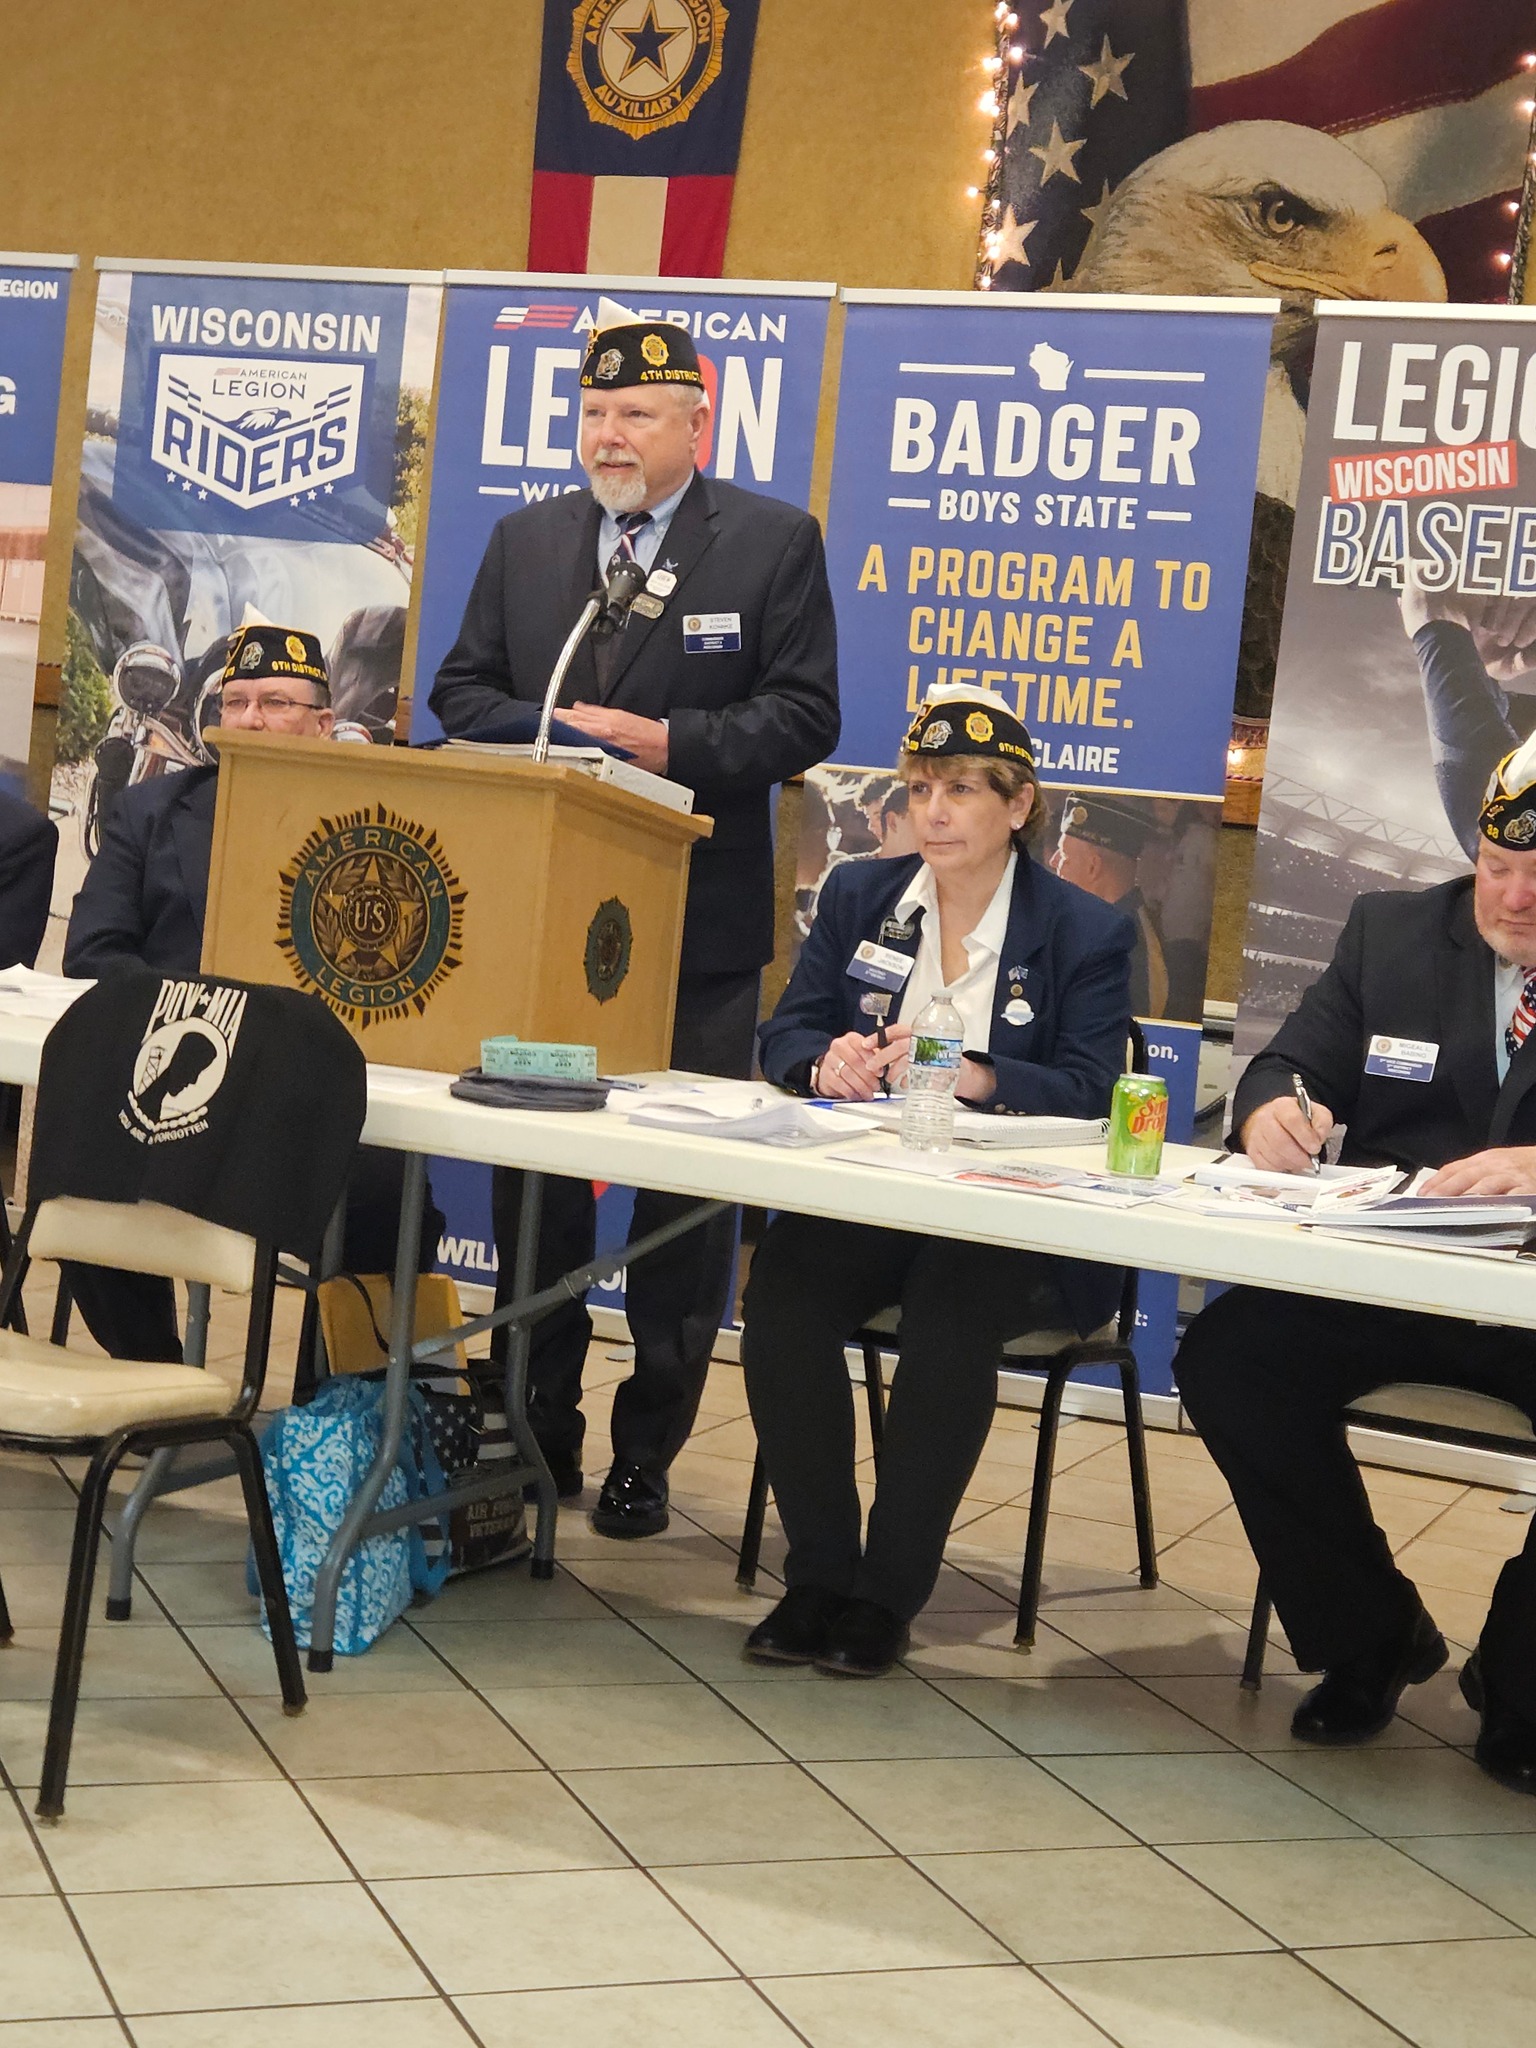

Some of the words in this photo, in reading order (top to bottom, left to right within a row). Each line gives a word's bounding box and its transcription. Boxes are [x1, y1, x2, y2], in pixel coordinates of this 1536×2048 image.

[593, 84, 684, 119] AUXILIARY
[151, 304, 382, 354] WISCONSIN
[211, 379, 306, 401] LEGION
[239, 368, 308, 381] AMERICAN
[640, 369, 664, 382] 4TH
[162, 405, 348, 496] RIDERS
[889, 397, 1201, 486] BADGER
[1334, 446, 1511, 500] WISCONSIN
[938, 489, 1020, 524] BOYS
[1034, 494, 1139, 530] STATE
[857, 544, 888, 593] A
[907, 546, 1135, 607] PROGRAM
[1154, 560, 1212, 612] TO
[907, 606, 1093, 665] CHANGE
[1111, 619, 1143, 669] A
[1030, 737, 1121, 775] CLAIRE
[304, 828, 444, 900] AMERICAN
[315, 965, 417, 1004] LEGION
[141, 979, 207, 1046] POW
[202, 986, 248, 1059] MIA
